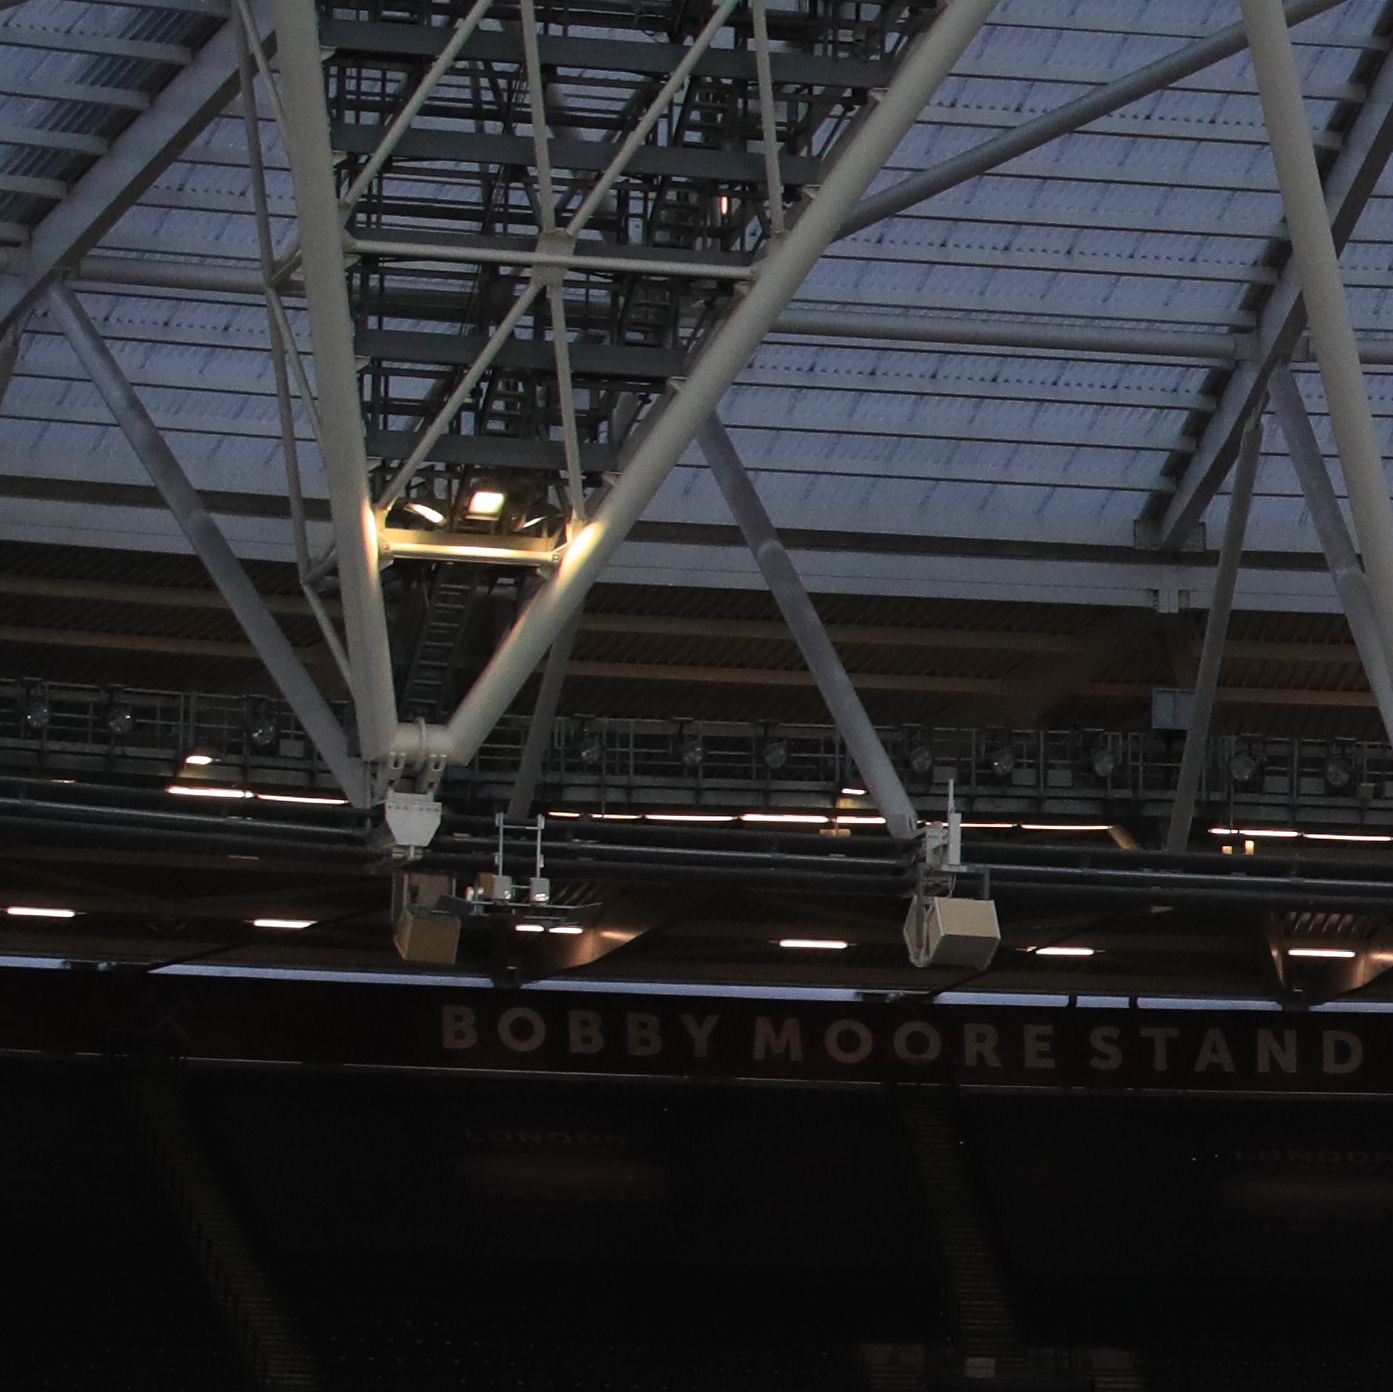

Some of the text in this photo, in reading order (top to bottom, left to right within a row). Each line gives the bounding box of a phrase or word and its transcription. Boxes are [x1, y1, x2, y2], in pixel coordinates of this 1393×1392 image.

[441, 1004, 1366, 1076] BOBBY MOORE STAND
